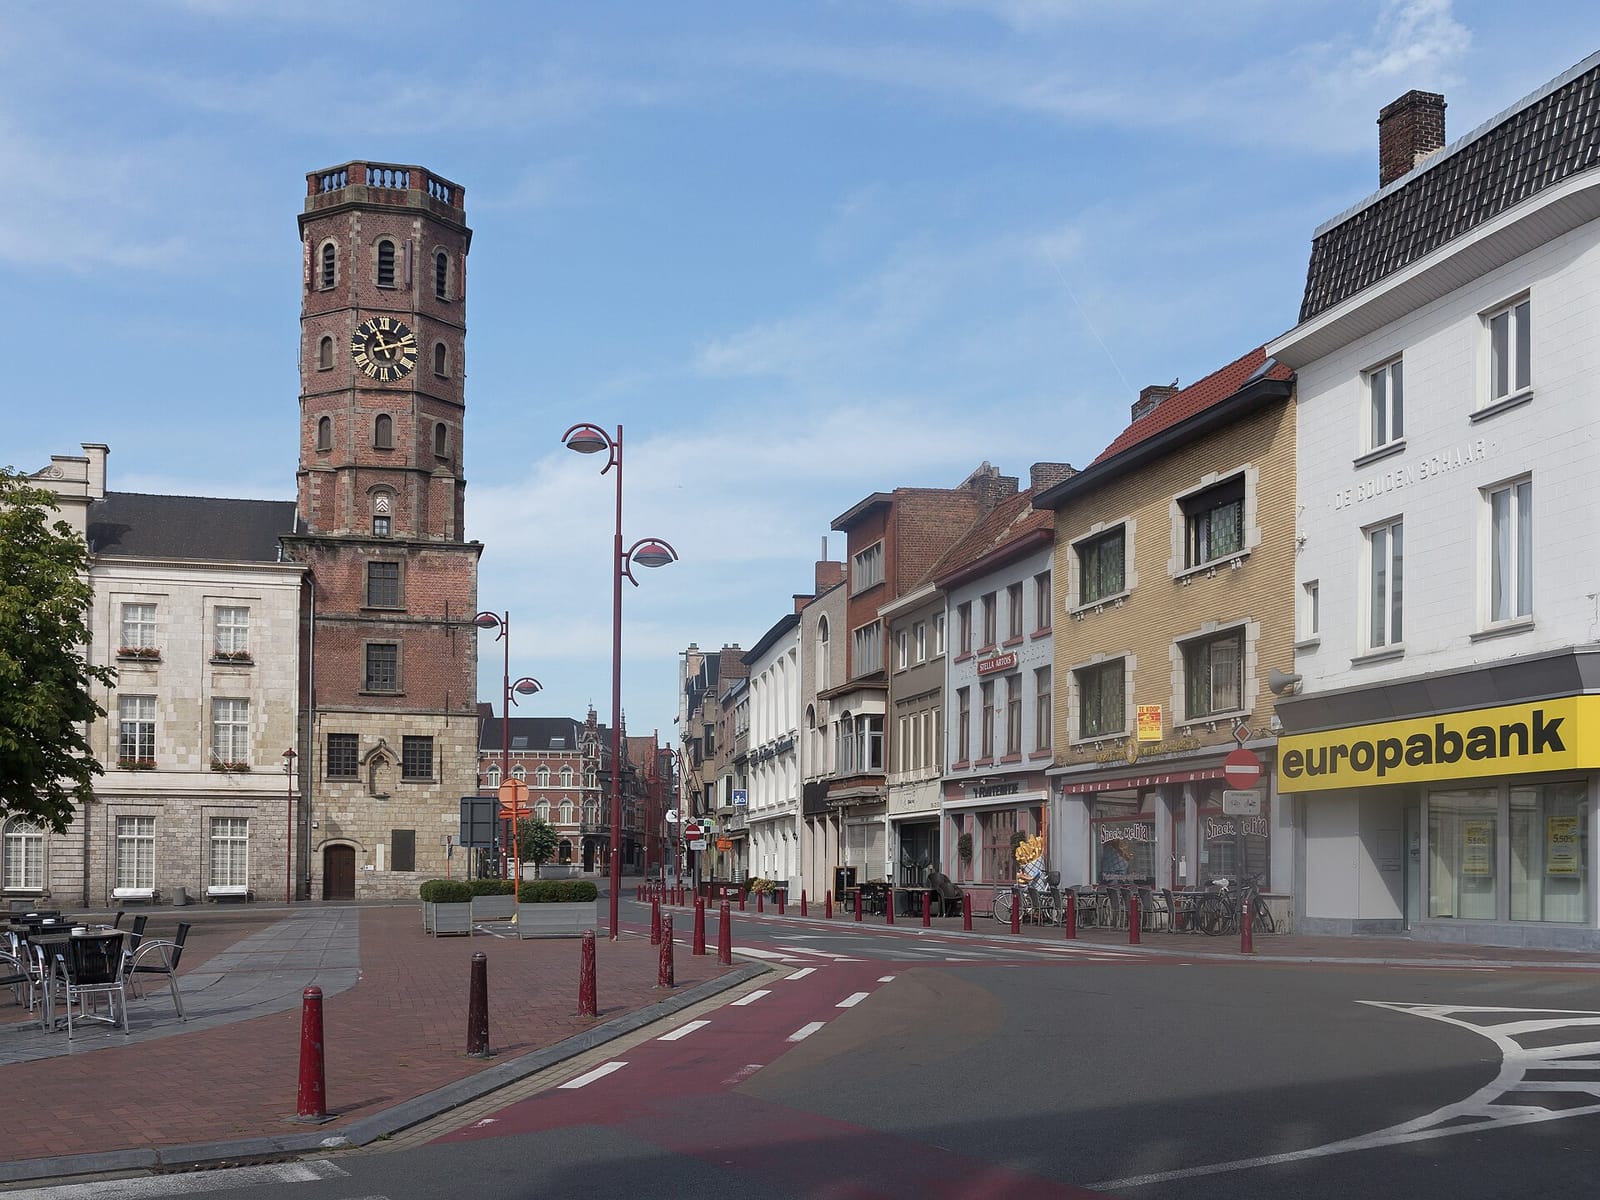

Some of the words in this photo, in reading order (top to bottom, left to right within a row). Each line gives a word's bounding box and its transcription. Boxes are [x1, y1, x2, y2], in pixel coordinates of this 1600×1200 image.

[1336, 489, 1352, 510] DE
[1420, 439, 1486, 480] SCHAAR
[980, 661, 994, 671] STELLA
[1282, 709, 1566, 779] europabank
[1207, 817, 1236, 840] Snack
